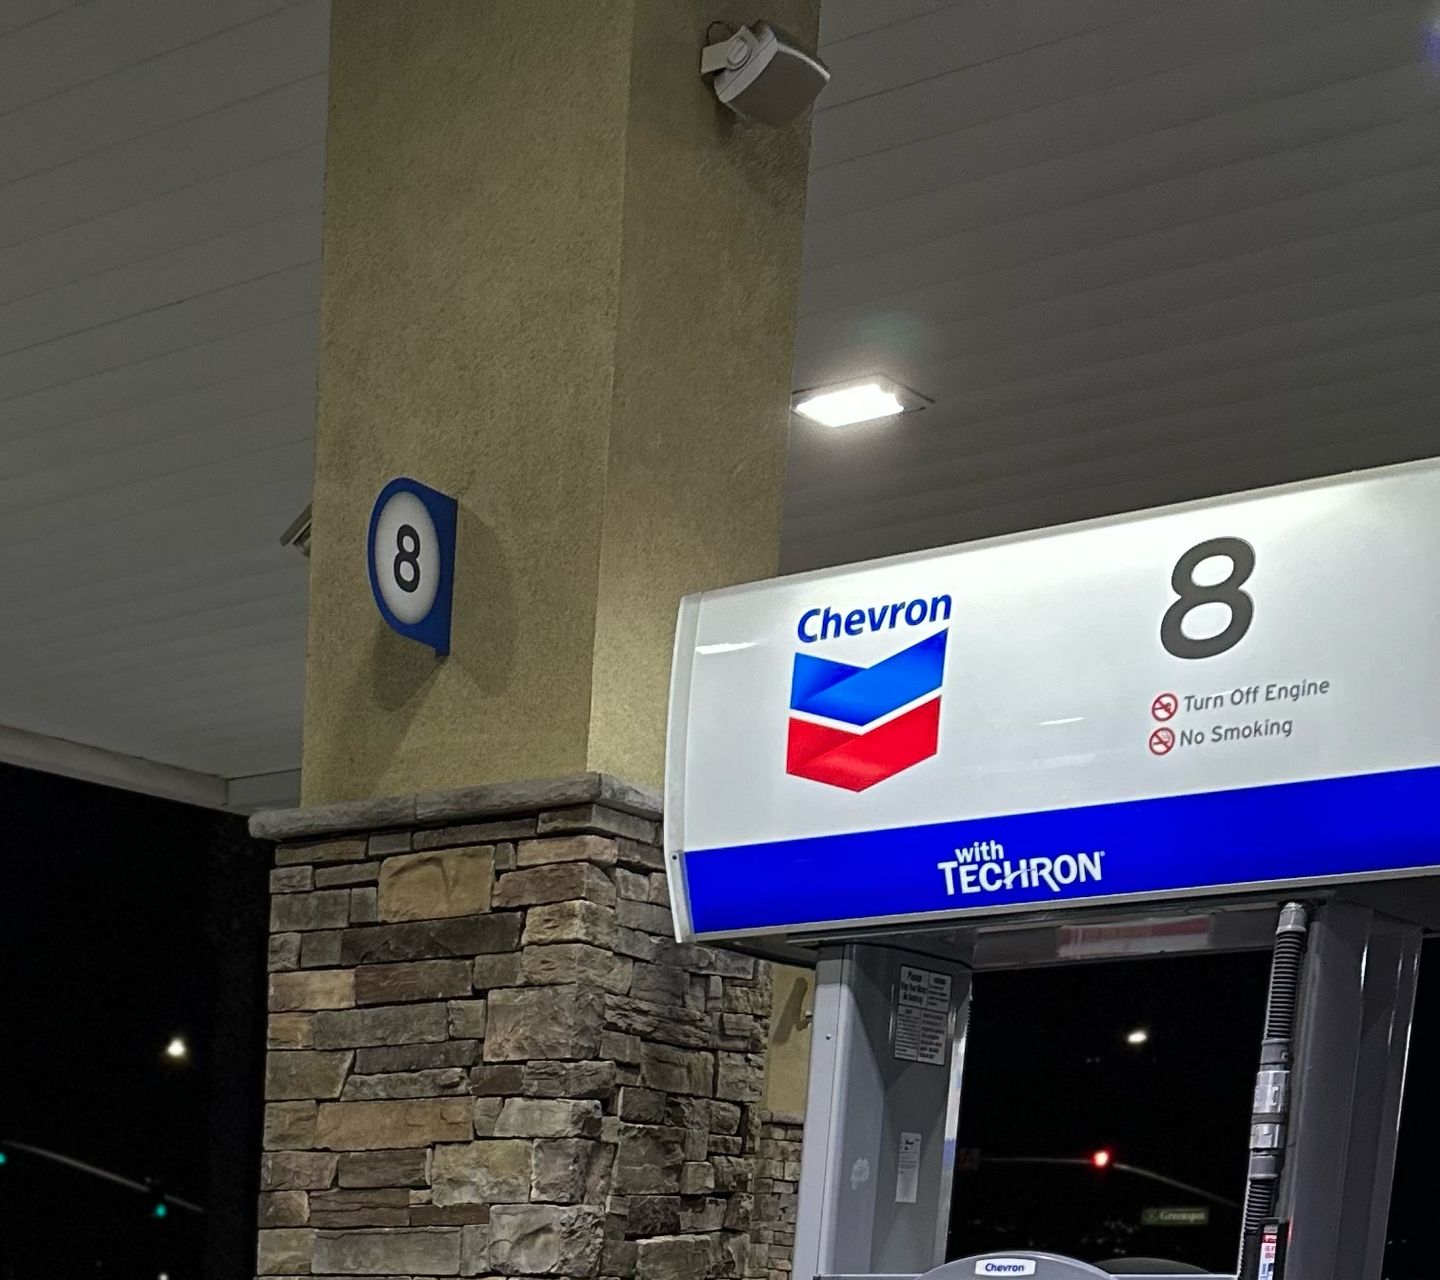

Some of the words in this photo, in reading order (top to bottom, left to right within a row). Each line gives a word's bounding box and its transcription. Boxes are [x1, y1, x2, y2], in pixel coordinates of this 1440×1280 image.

[394, 524, 420, 593] 8
[1160, 536, 1256, 660] 8
[797, 594, 953, 643] Chevron
[1184, 693, 1224, 712] Turn
[1230, 686, 1260, 706] Off
[1265, 679, 1330, 701] Engine
[1180, 729, 1205, 747] No
[1211, 718, 1293, 744] Smoking
[954, 840, 1004, 864] with
[937, 851, 1103, 895] TECHRON
[985, 1262, 1025, 1273] Chevron
